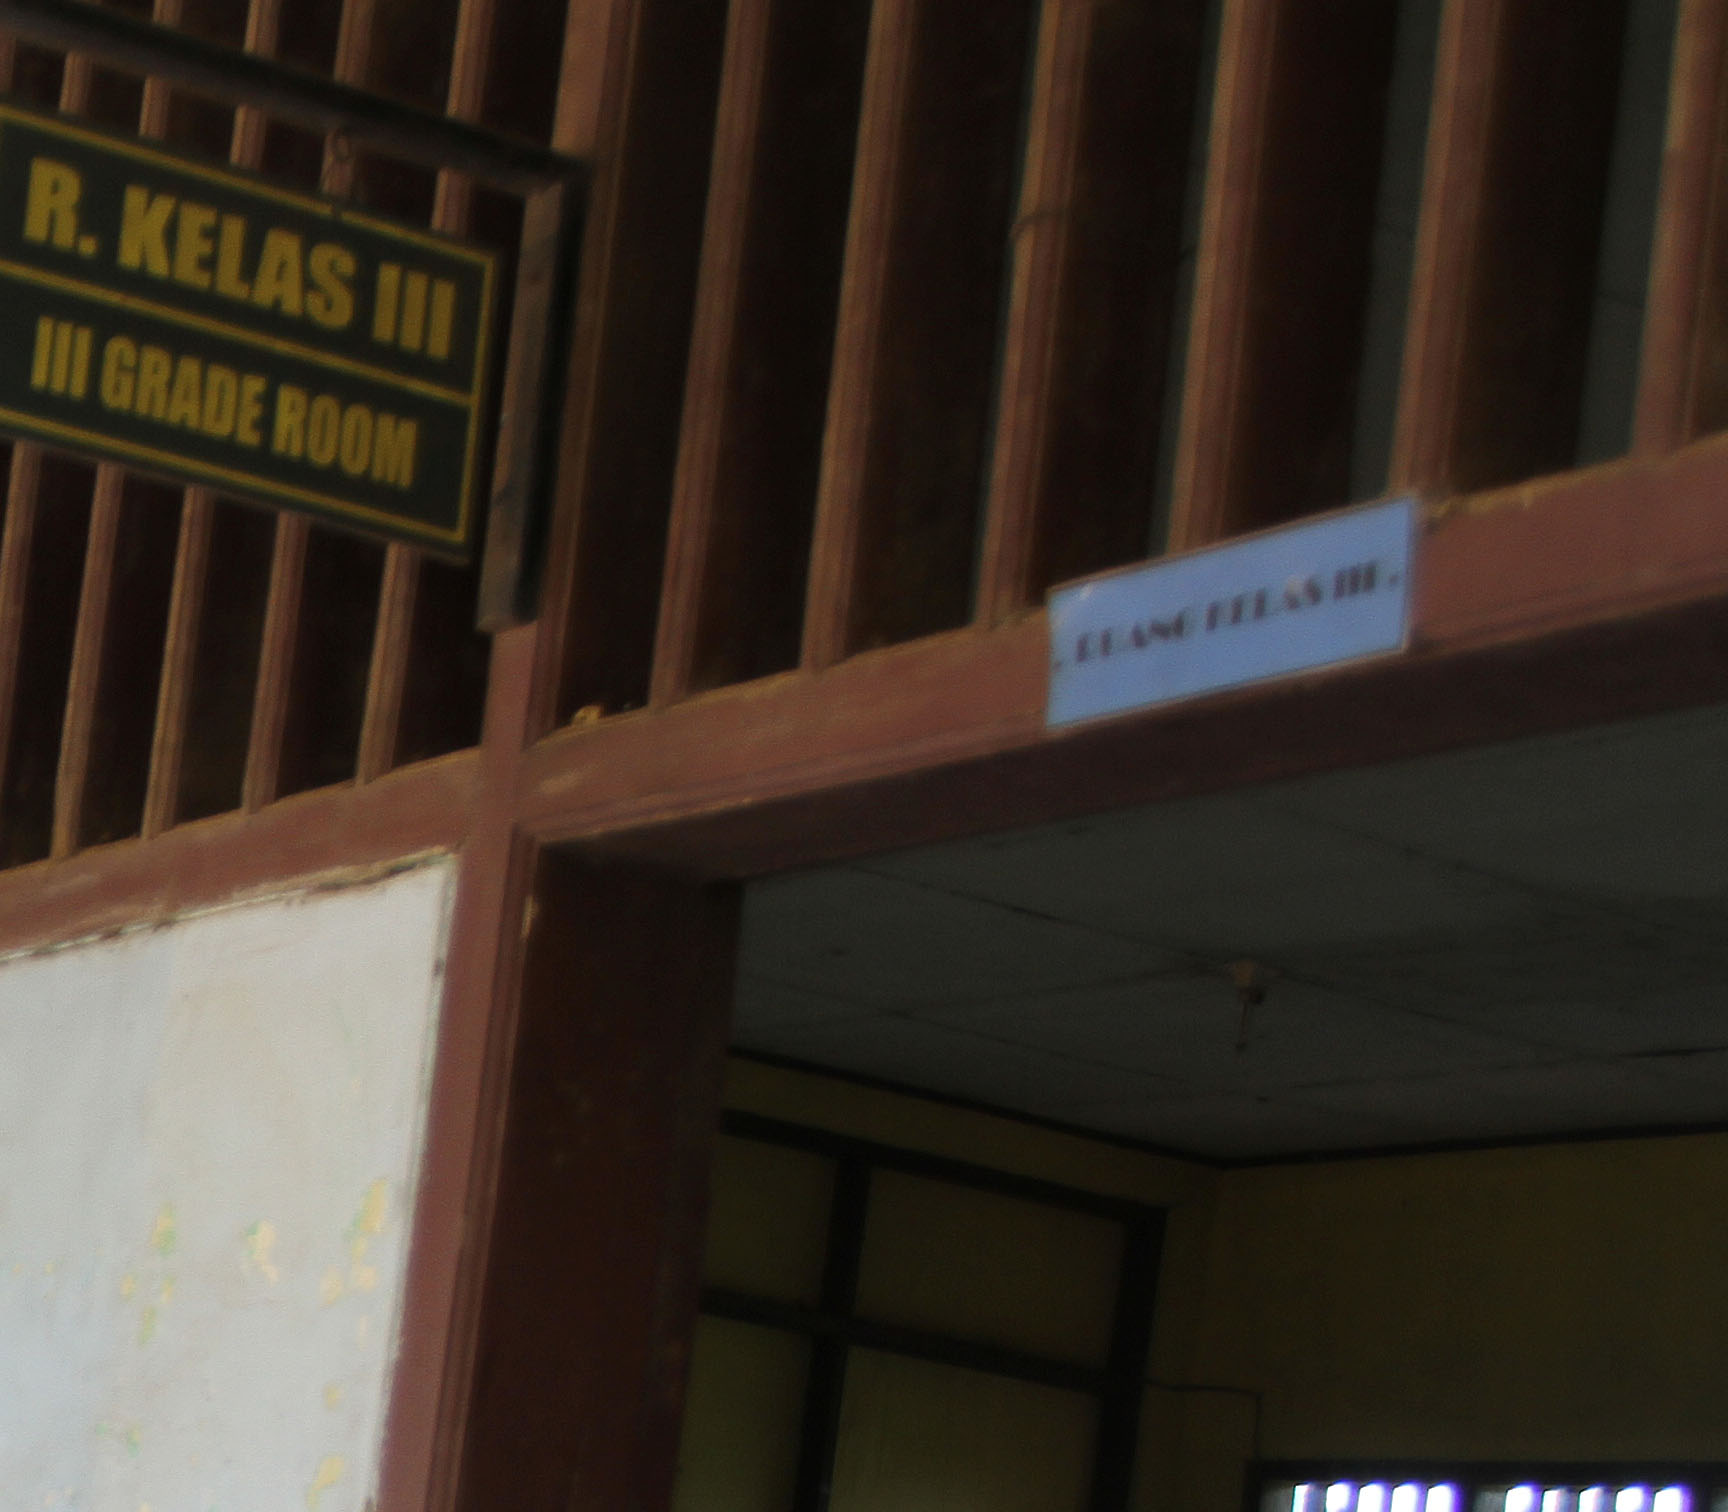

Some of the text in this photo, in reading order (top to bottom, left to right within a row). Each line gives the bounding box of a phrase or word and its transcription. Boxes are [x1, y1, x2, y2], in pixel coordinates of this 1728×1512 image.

[23, 156, 458, 361] R. KELAS III
[31, 316, 419, 491] III GRADE ROOM
